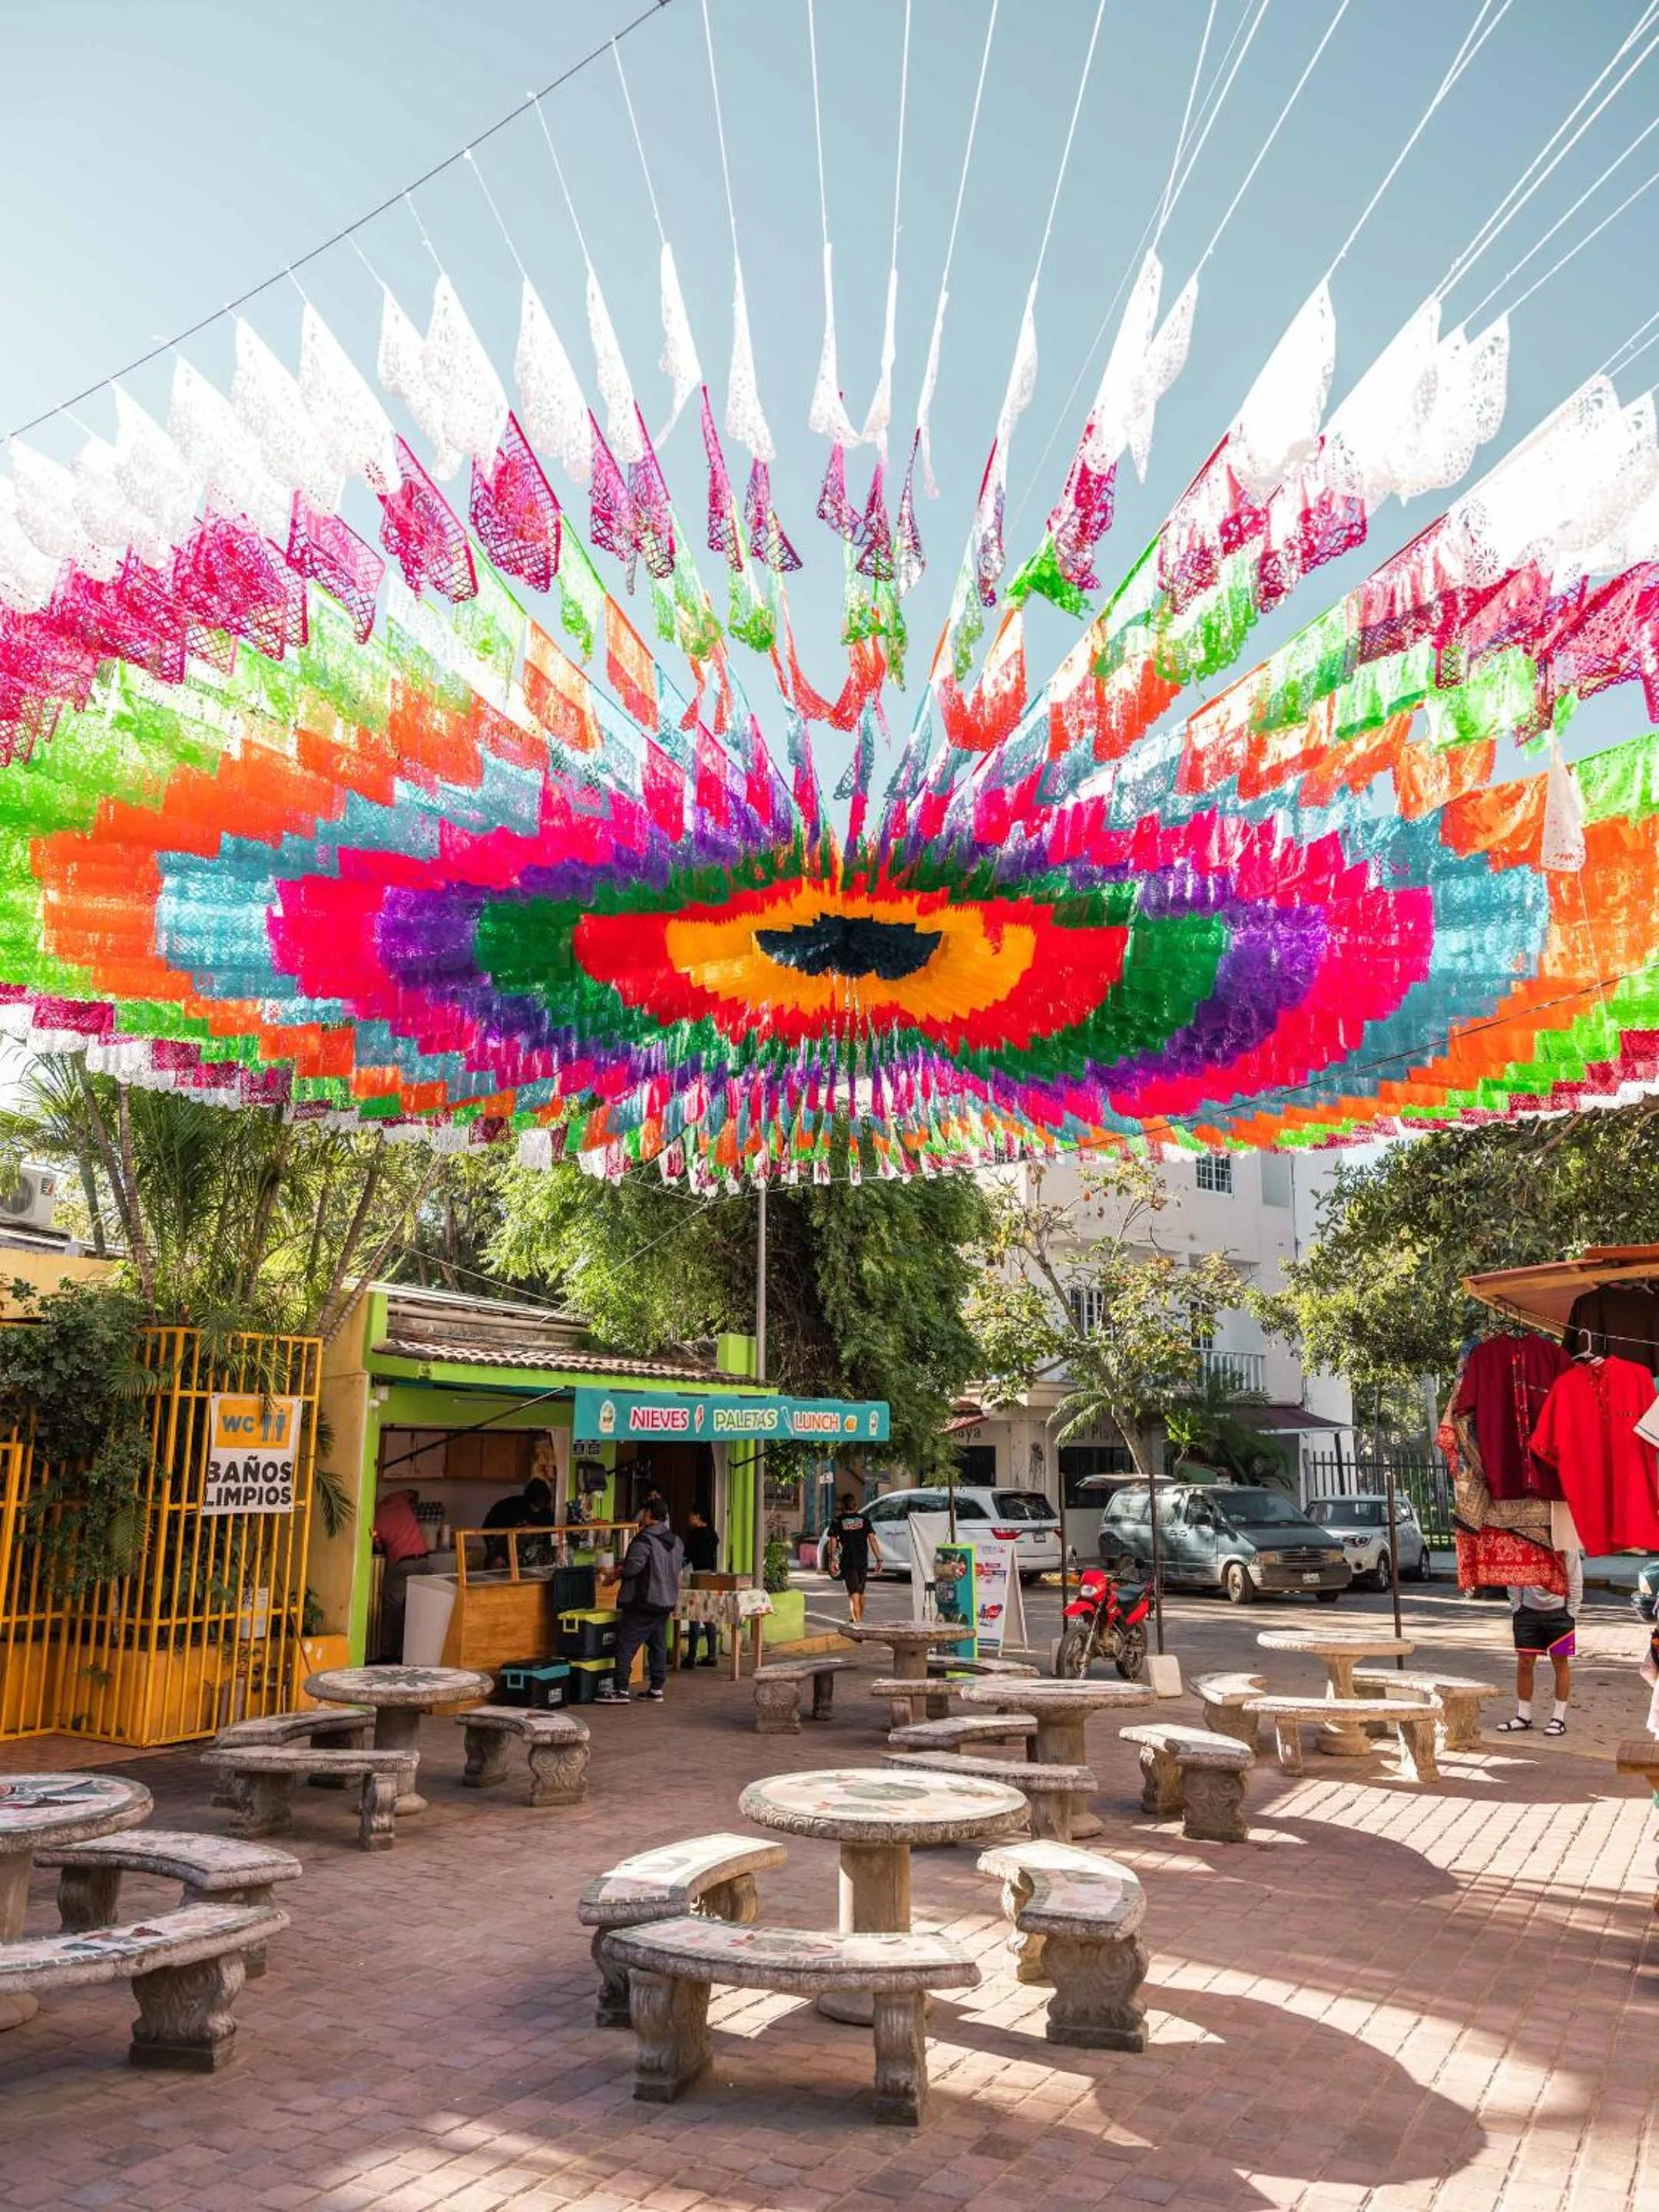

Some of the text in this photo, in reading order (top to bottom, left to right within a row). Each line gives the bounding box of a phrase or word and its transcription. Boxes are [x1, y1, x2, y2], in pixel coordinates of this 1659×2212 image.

[221, 1416, 255, 1433] WC
[631, 1409, 839, 1431] NIEVES PALETAS LUNCH
[207, 1455, 292, 1483] BAÑOS
